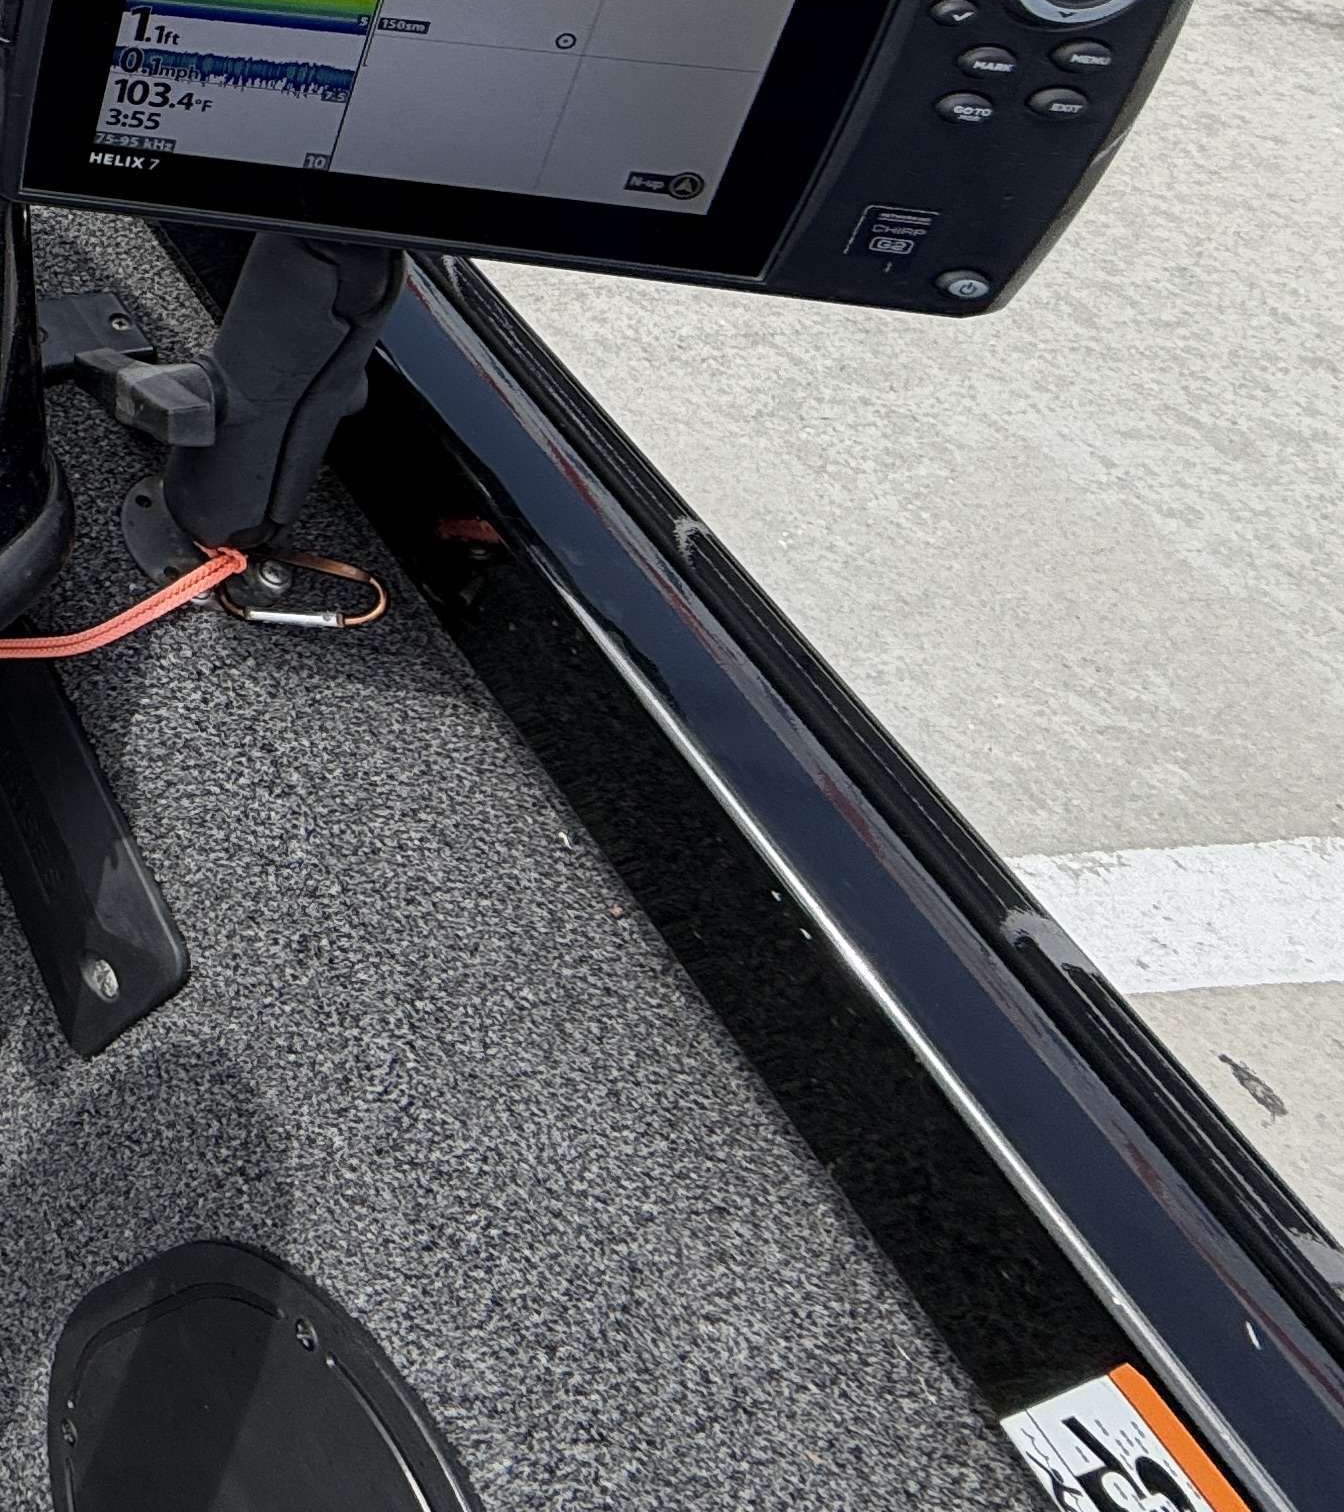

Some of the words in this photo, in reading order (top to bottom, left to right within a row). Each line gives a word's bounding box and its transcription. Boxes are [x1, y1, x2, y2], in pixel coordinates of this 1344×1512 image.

[972, 60, 1015, 73] MARK
[1069, 53, 1111, 66] MENU
[1049, 102, 1084, 114] EXIT
[105, 107, 162, 131] 3:55
[89, 151, 146, 169] HELIX
[149, 158, 161, 171] 7
[306, 155, 327, 169] 10
[872, 224, 927, 237] CHIRP
